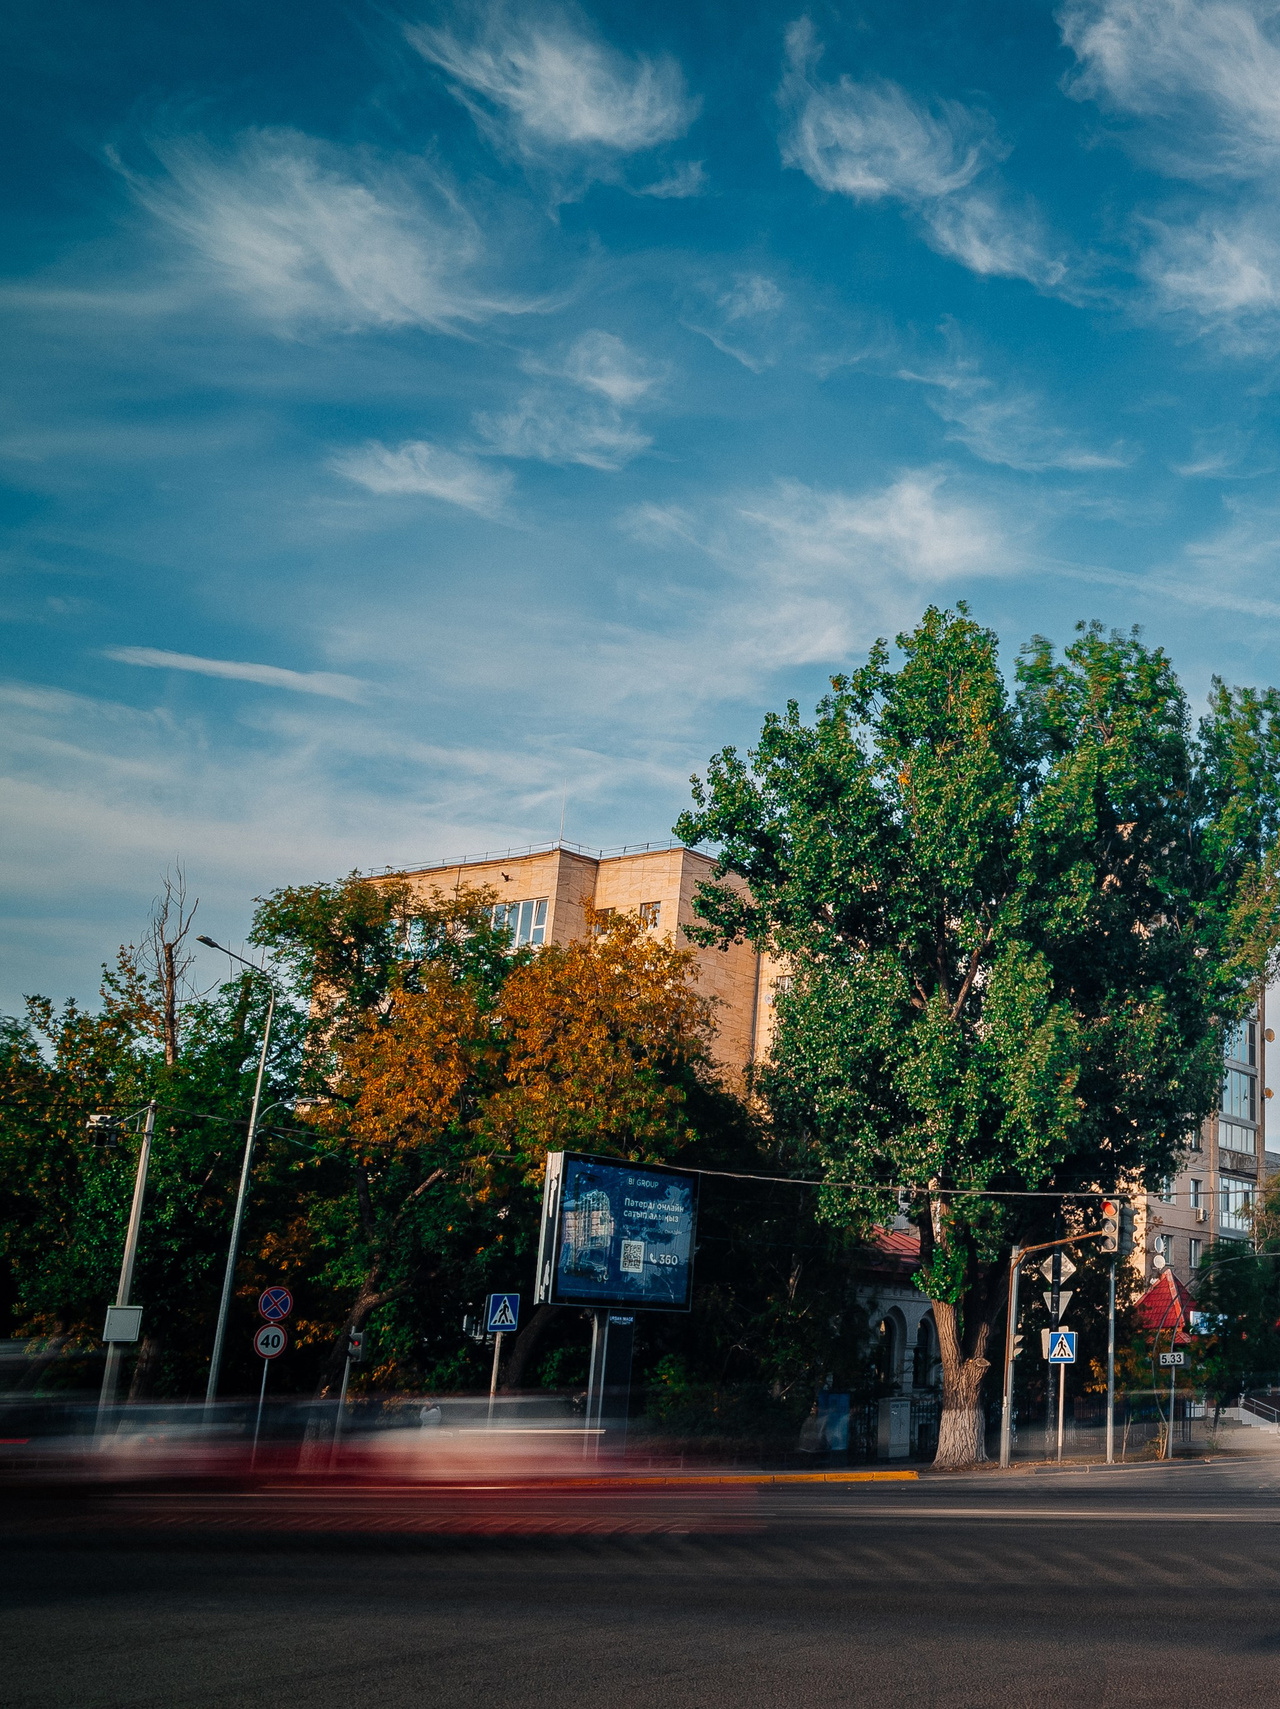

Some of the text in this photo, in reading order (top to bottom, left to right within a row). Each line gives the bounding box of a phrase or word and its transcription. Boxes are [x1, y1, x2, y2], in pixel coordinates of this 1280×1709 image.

[628, 1177, 659, 1188] BI GROUP
[656, 1203, 685, 1213] онлайн
[623, 1210, 647, 1220] сатып
[659, 1254, 678, 1266] 360
[260, 1334, 280, 1348] 40
[1161, 1354, 1182, 1364] 5.33
